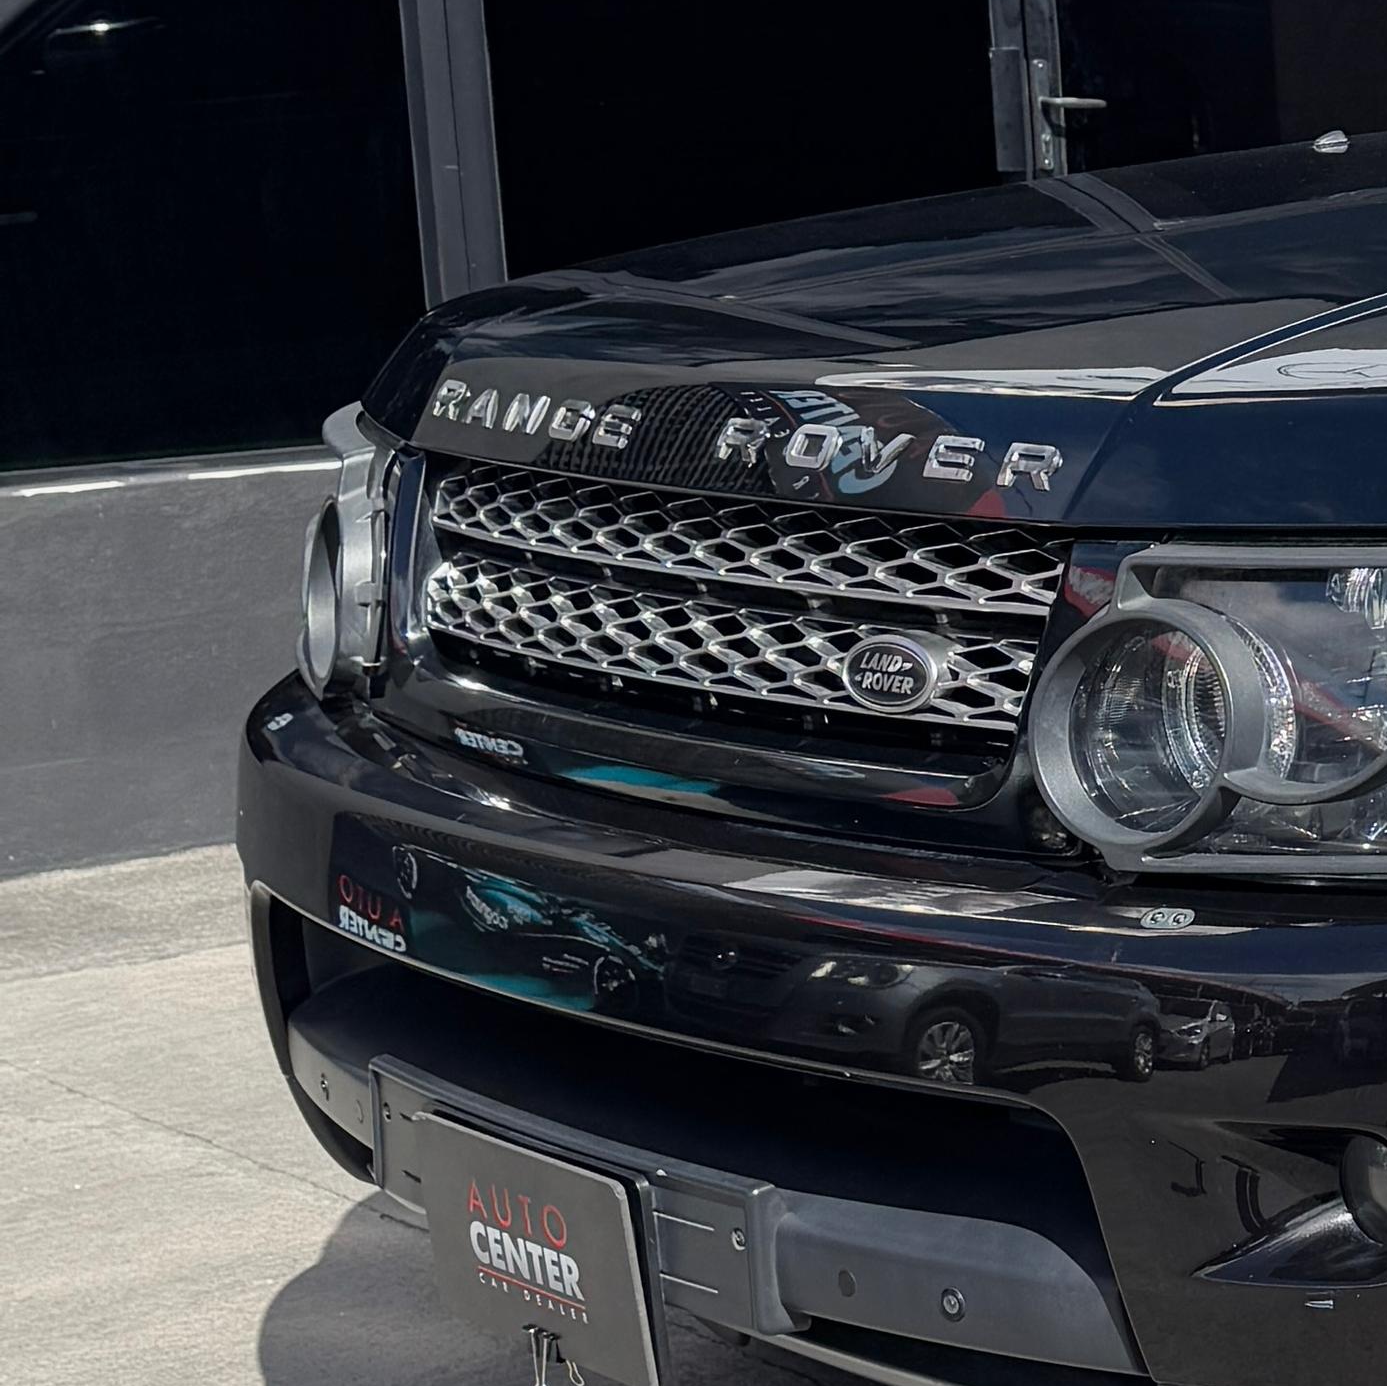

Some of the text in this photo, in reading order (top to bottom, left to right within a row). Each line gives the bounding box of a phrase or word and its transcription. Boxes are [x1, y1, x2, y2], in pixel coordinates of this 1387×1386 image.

[431, 379, 1064, 492] RANGE ROVER
[860, 652, 903, 673] LAND
[861, 671, 915, 695] ROVER
[468, 1178, 567, 1249] AUTO
[470, 1220, 585, 1302] CENTER
[479, 1272, 509, 1294] CAR
